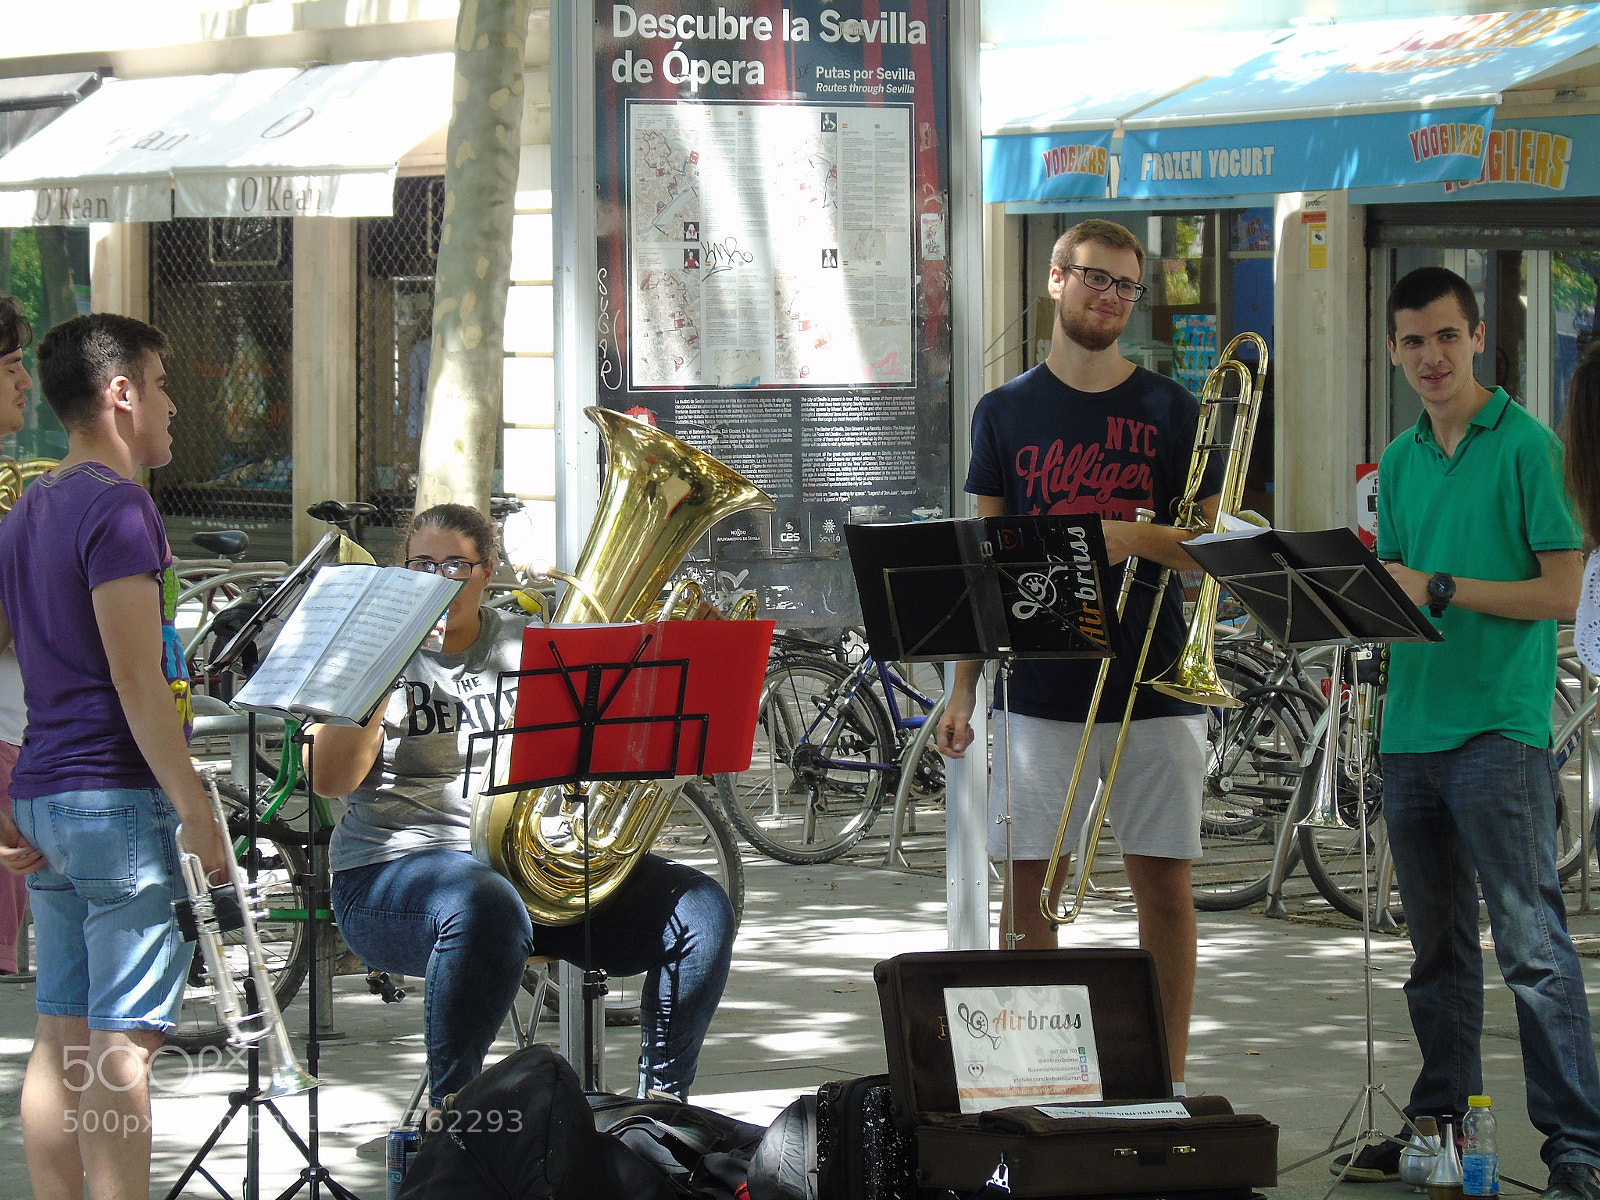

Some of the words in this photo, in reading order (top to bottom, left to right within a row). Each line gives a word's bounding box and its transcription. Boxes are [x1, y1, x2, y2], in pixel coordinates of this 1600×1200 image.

[612, 4, 773, 41] Descubre
[782, 8, 810, 42] la
[819, 9, 927, 45] Sevilla
[611, 50, 654, 84] de
[662, 41, 765, 93] Ópera
[816, 66, 851, 79] Putas
[853, 69, 874, 82] por
[876, 67, 916, 81] Sevilla
[816, 82, 848, 93] Routes
[850, 83, 884, 95] through
[886, 84, 915, 94] Sevilla
[1408, 123, 1485, 163] YOOGLERS
[1444, 129, 1573, 194] GLERS
[1041, 144, 1108, 180] YOOGLERS
[1141, 150, 1203, 181] FROZEN
[1208, 146, 1275, 179] YOGURT
[36, 186, 109, 221] O'Kean
[241, 175, 322, 212] O'Kean
[1105, 416, 1158, 457] NYC
[1015, 438, 1154, 504] Hilfiger
[1066, 526, 1108, 646] Airbrass
[452, 676, 482, 695] THE
[992, 1008, 1083, 1035] Airbrass
